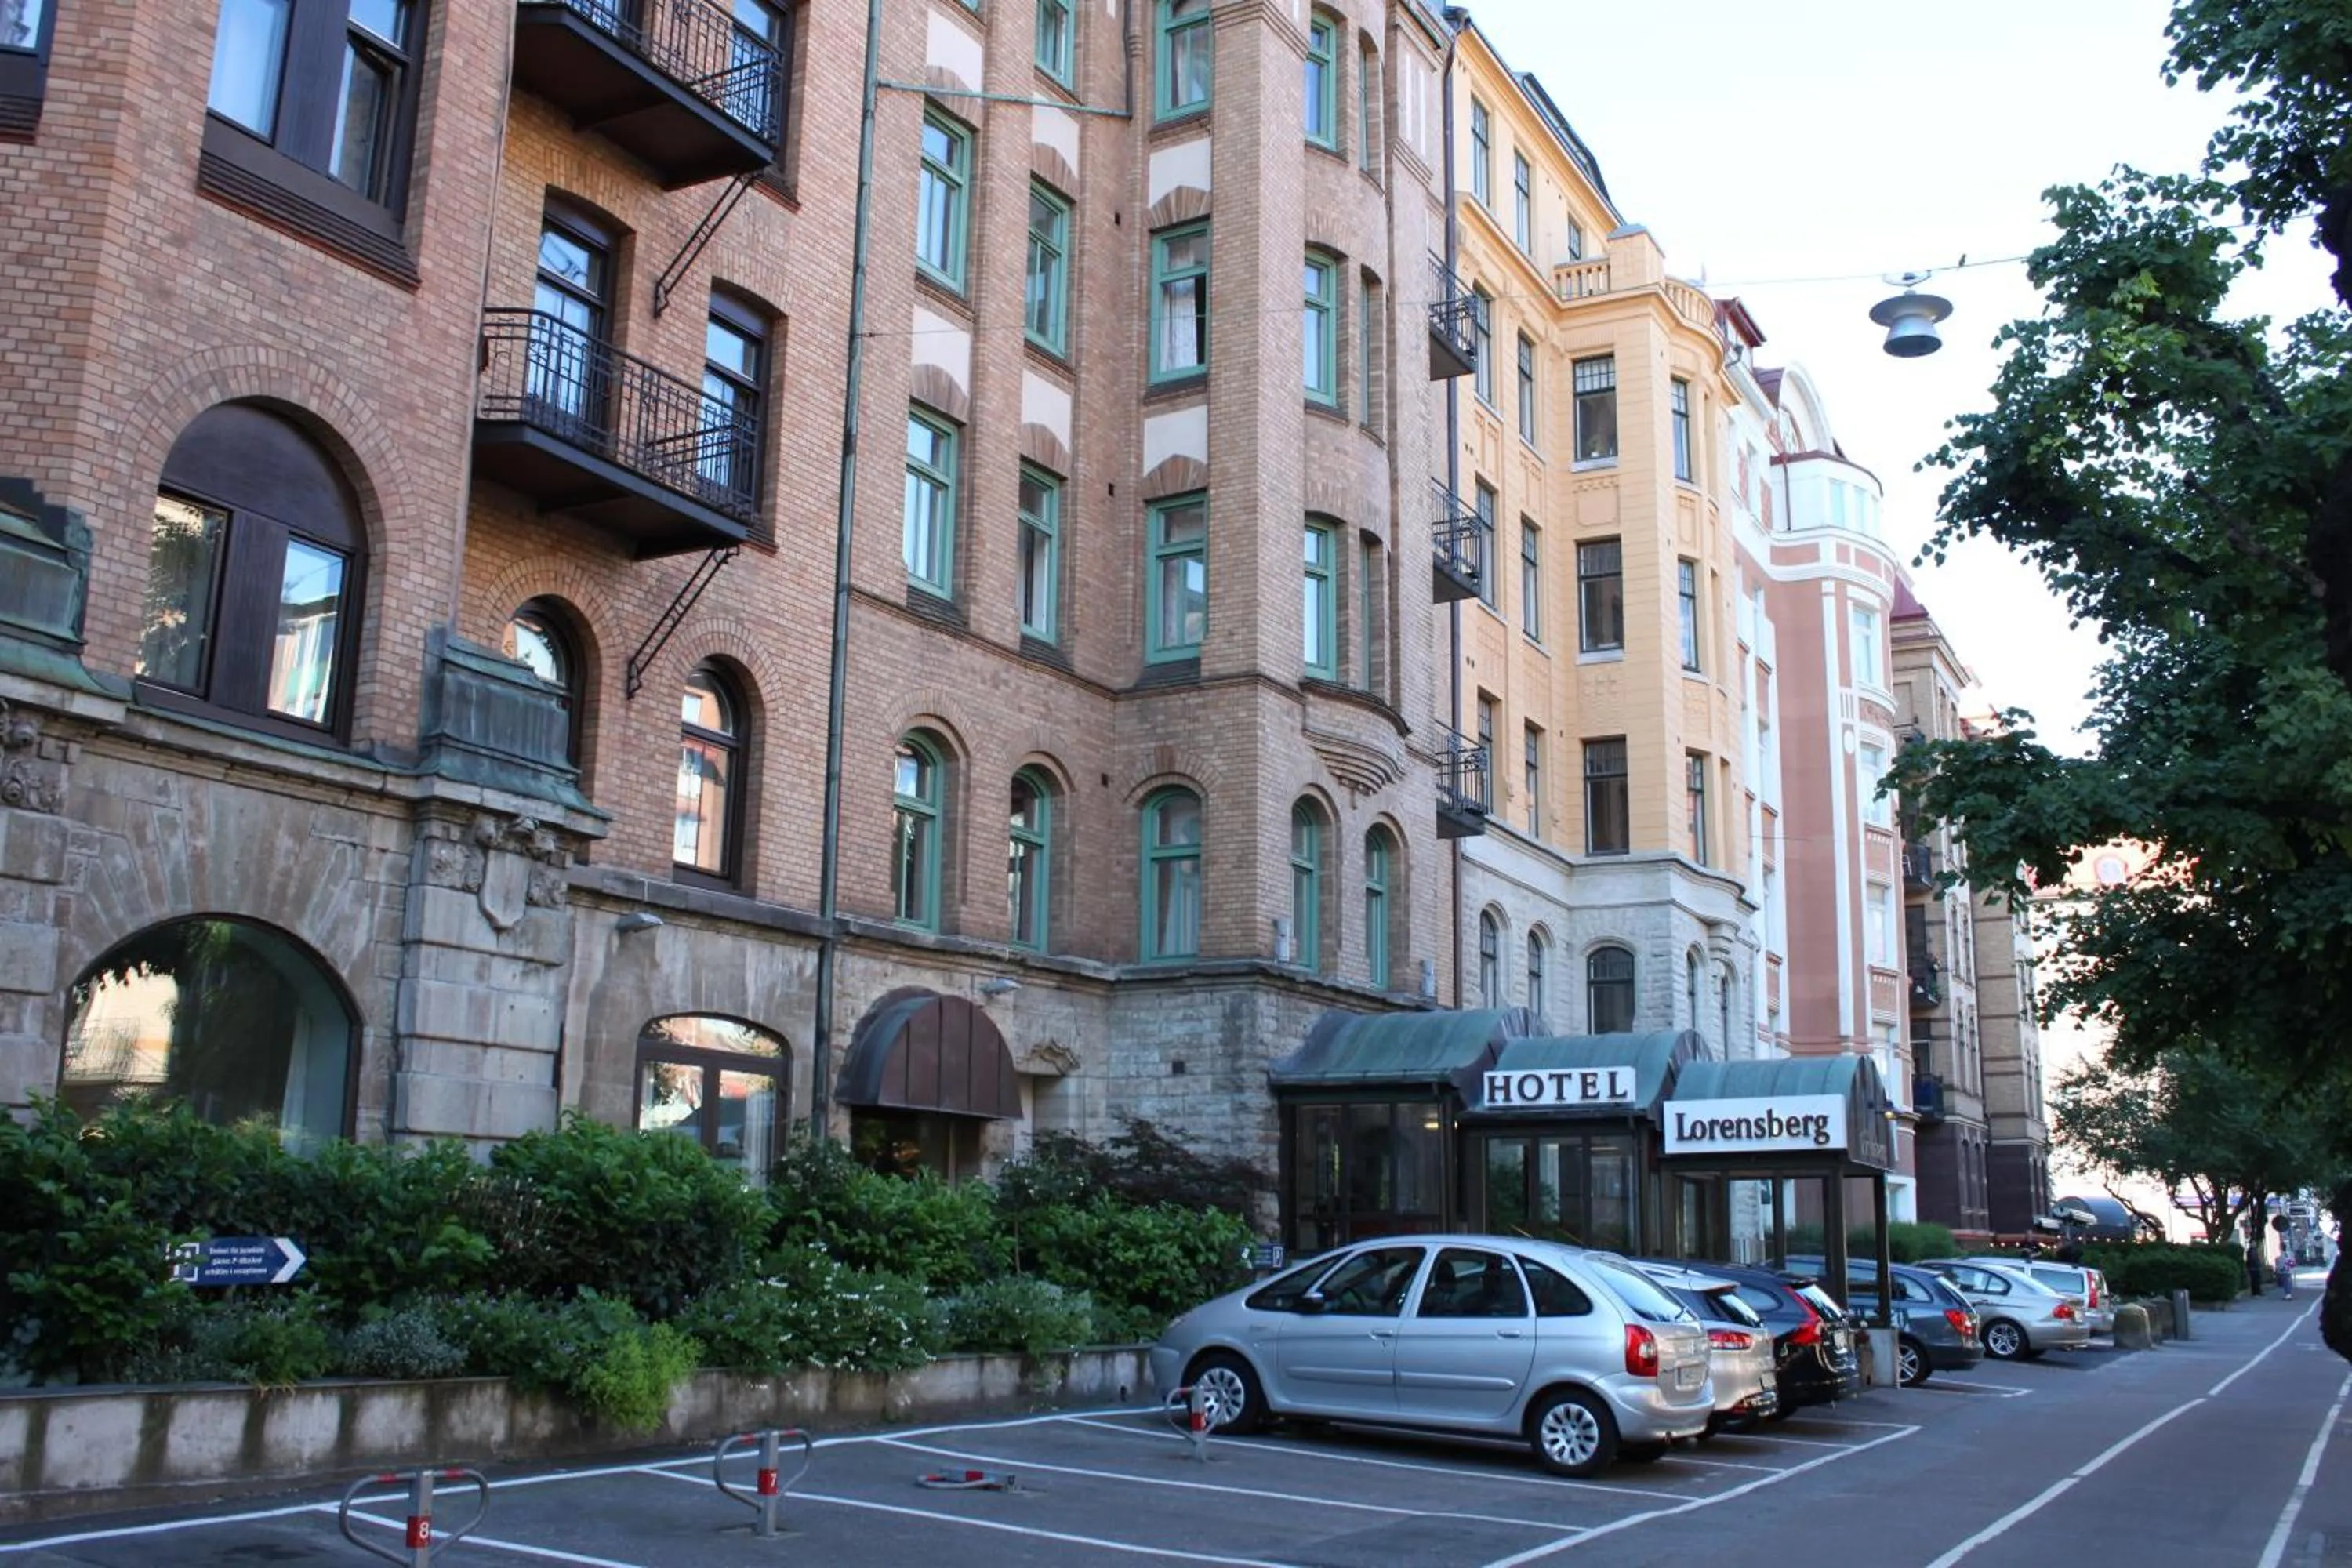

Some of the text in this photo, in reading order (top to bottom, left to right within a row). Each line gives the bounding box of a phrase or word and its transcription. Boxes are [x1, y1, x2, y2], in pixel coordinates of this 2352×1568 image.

[1486, 1071, 1628, 1103] HOTEL
[1675, 1108, 1830, 1145] Lorensberg
[770, 1473, 777, 1488] 7
[419, 1521, 430, 1539] 8
